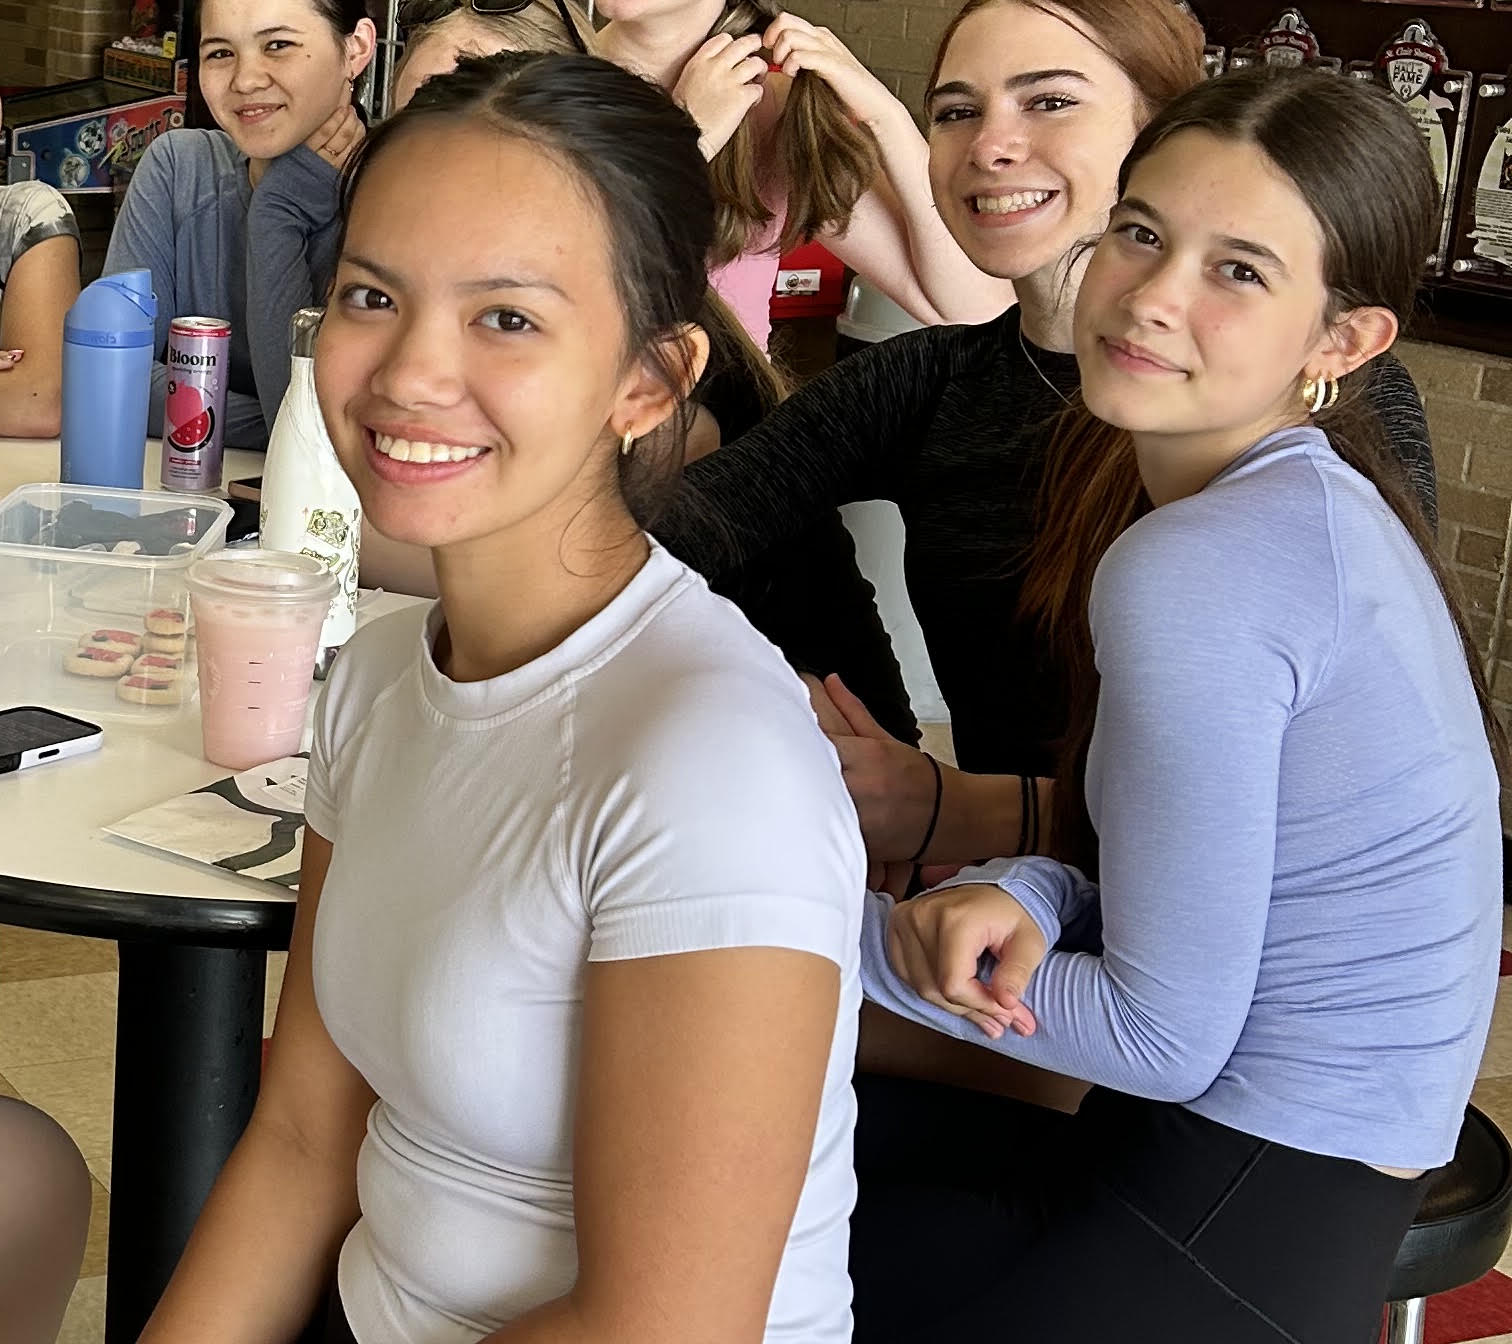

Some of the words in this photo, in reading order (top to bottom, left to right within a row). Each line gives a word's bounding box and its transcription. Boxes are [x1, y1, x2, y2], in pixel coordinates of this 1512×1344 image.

[1394, 64, 1415, 73] HALL
[1393, 72, 1424, 84] FAME
[170, 347, 216, 366] Bloom
